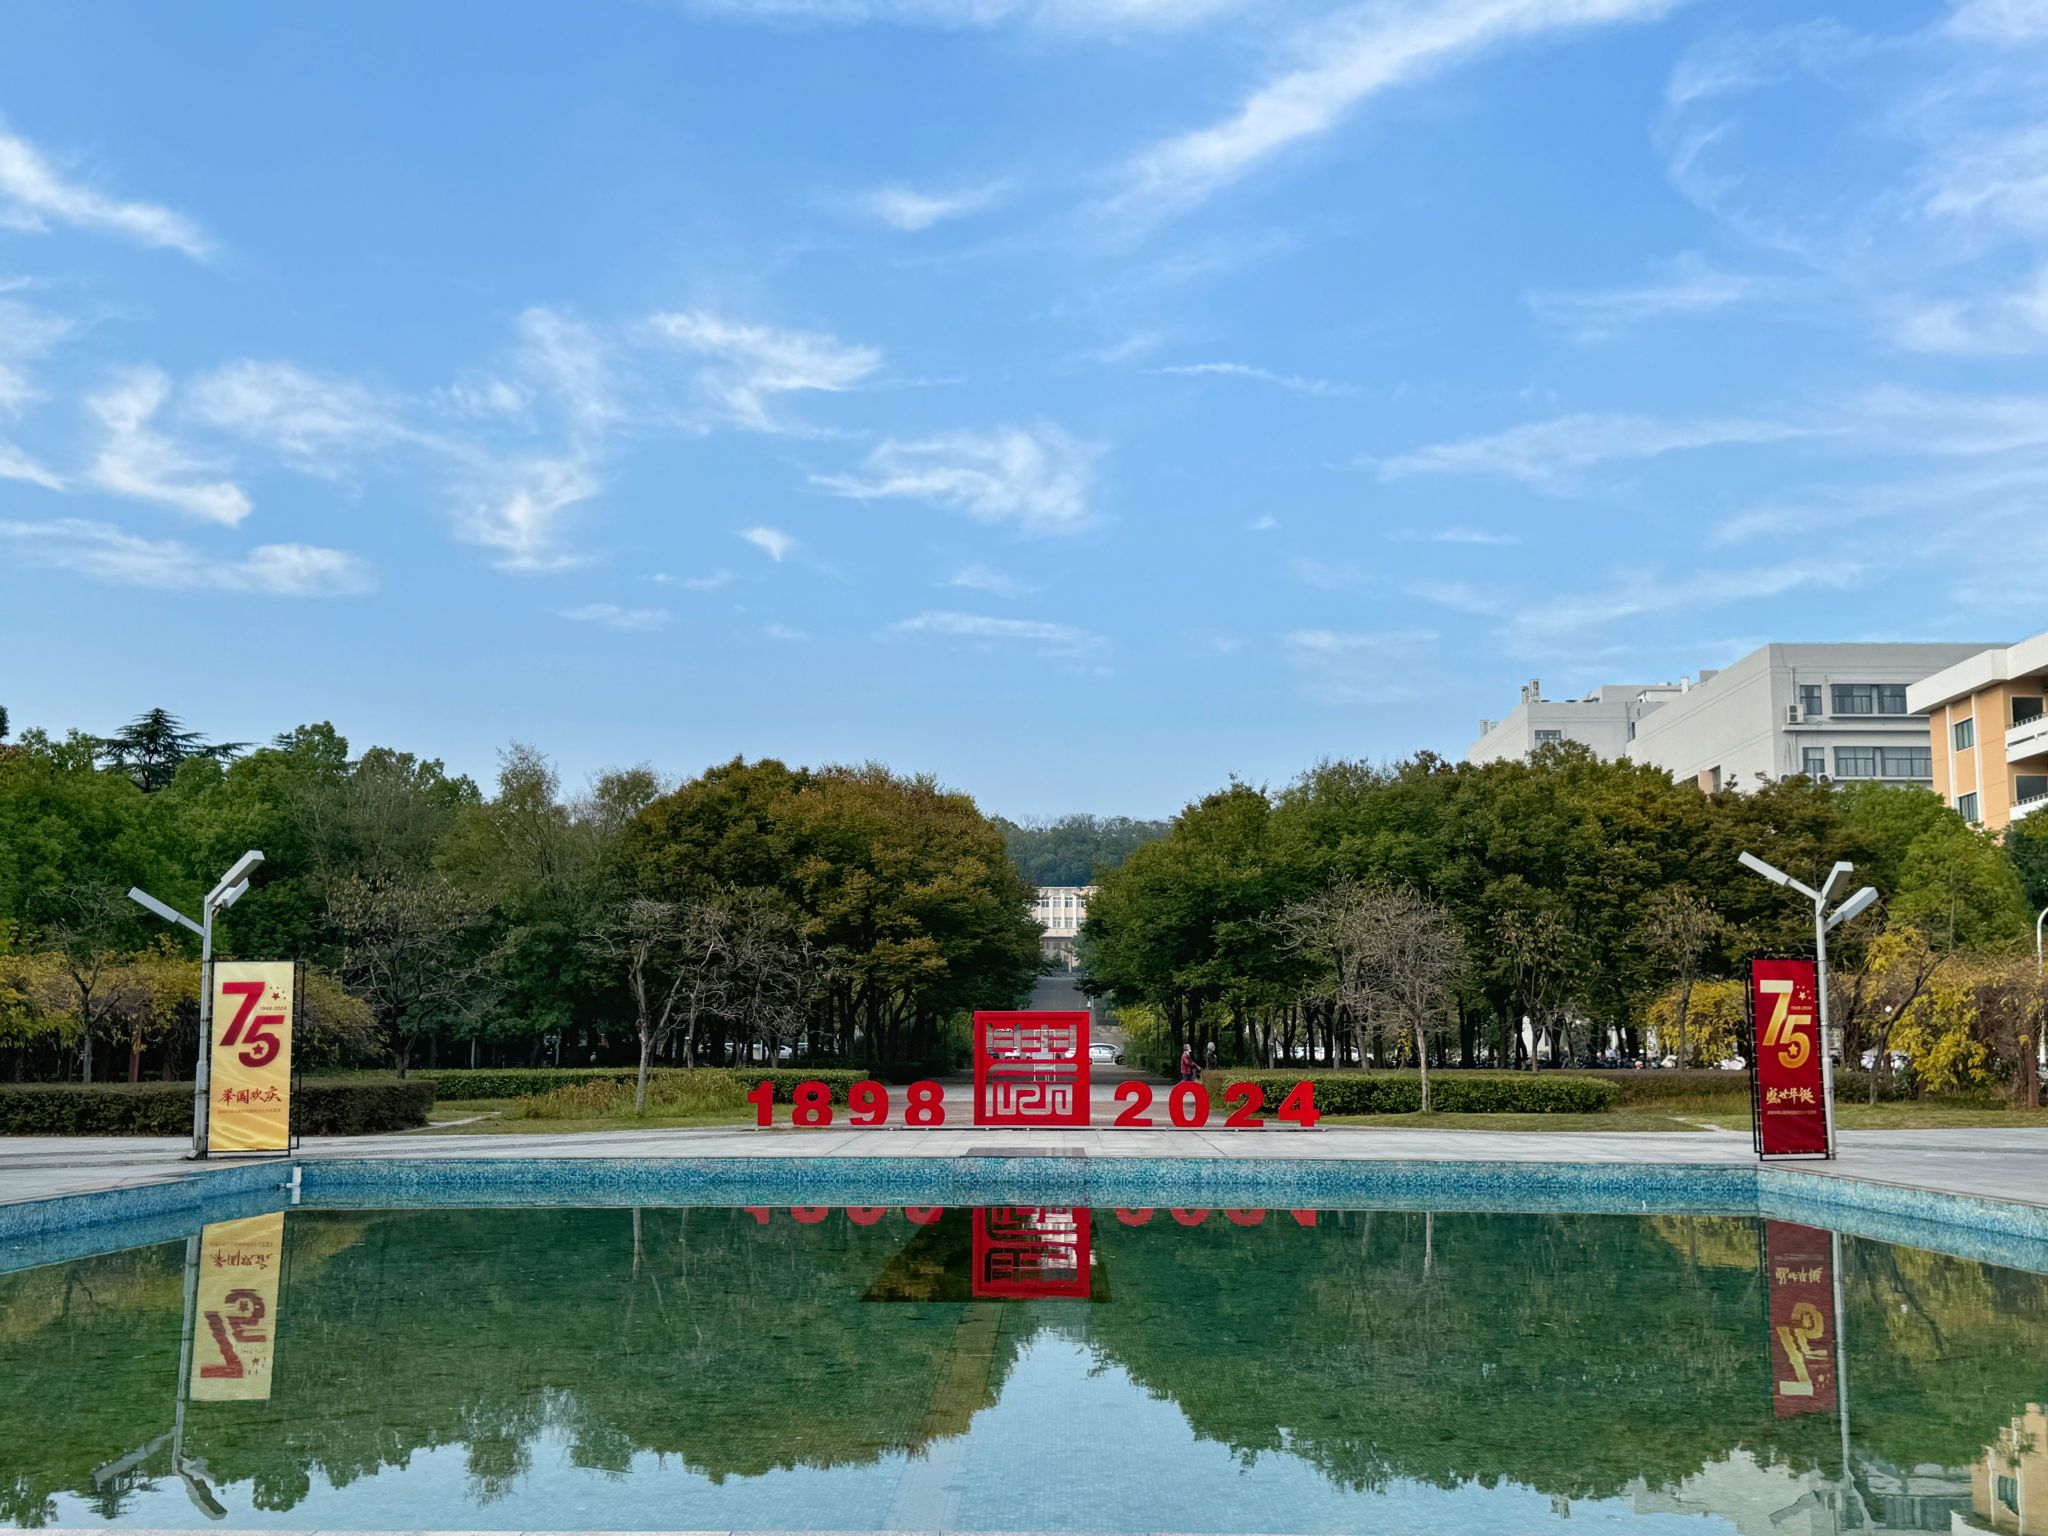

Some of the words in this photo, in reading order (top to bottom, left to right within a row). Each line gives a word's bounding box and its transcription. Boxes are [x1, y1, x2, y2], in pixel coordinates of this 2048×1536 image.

[219, 981, 285, 1068] 75
[1759, 979, 1812, 1069] 75
[217, 1085, 282, 1107] 举国欢庆
[747, 1079, 945, 1126] 1898
[1114, 1079, 1322, 1128] 2024
[1766, 1086, 1817, 1105] 盛世华诞
